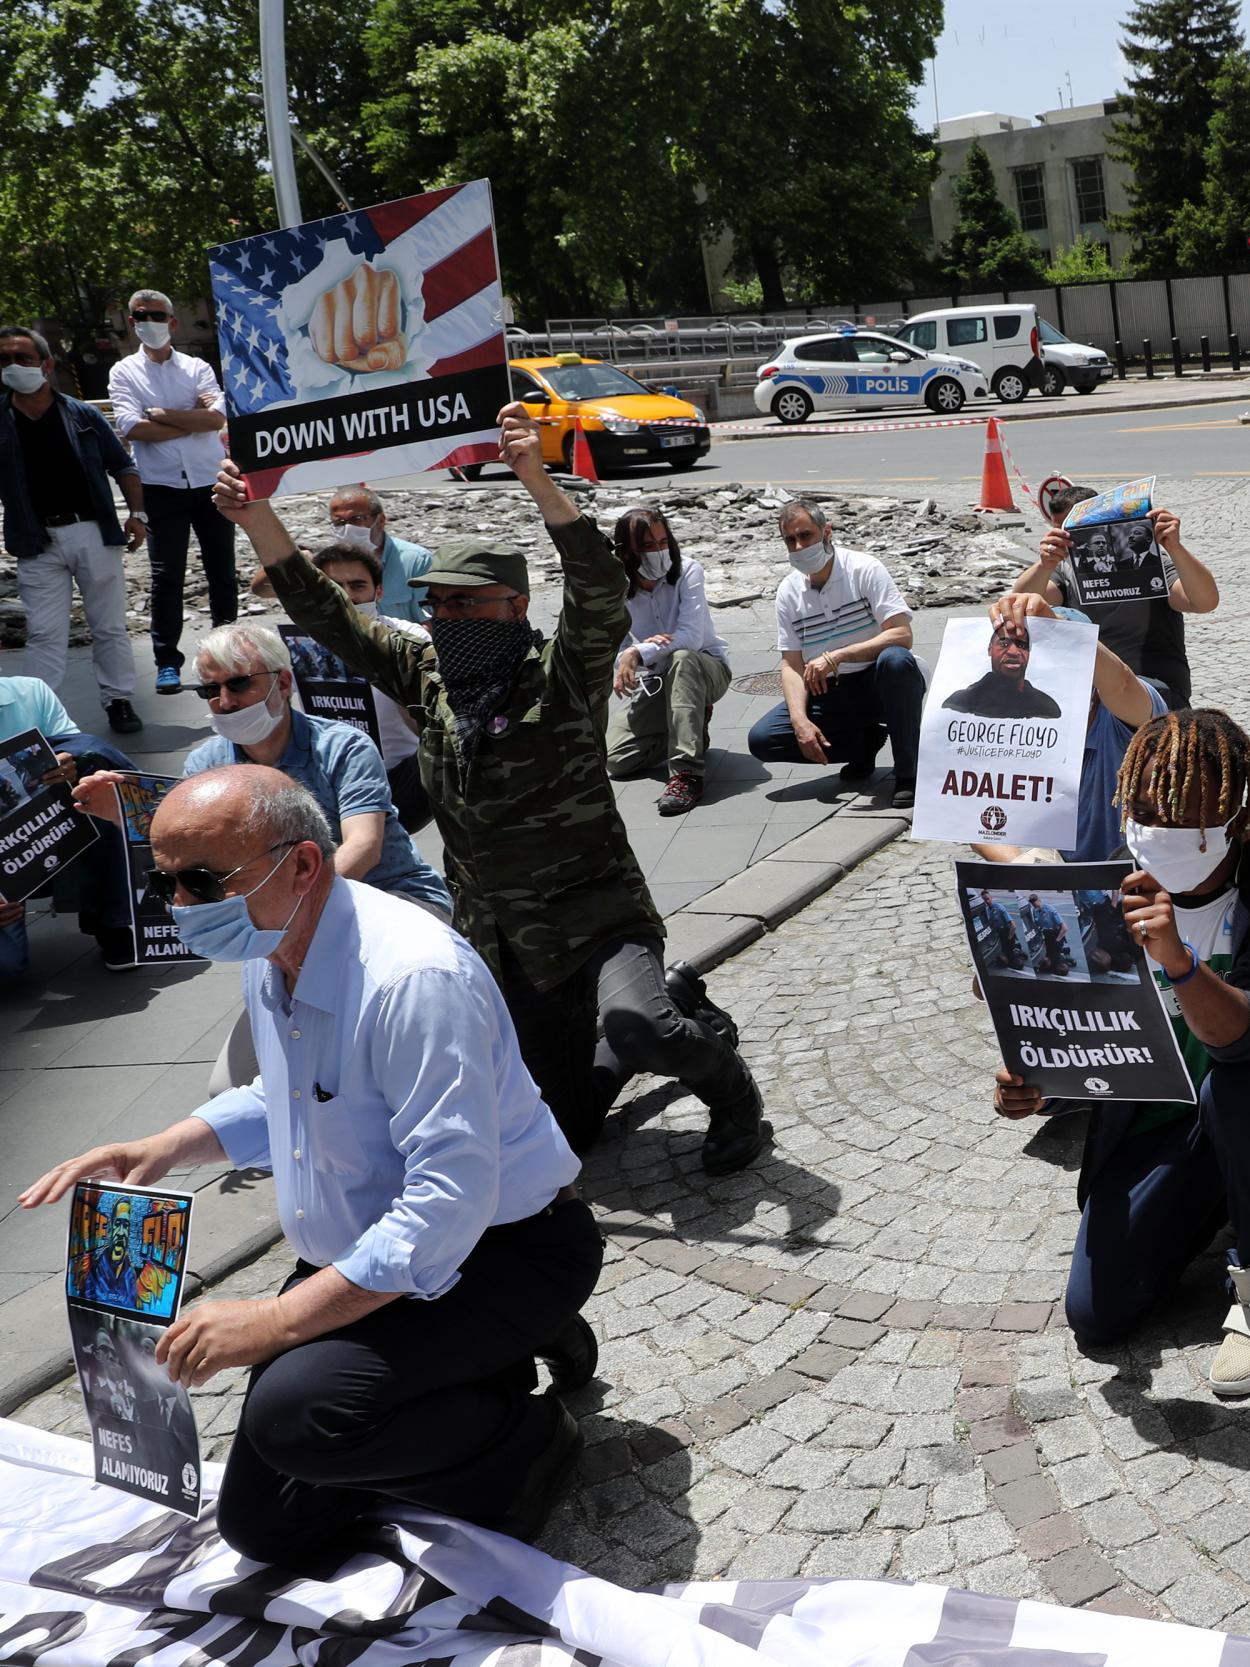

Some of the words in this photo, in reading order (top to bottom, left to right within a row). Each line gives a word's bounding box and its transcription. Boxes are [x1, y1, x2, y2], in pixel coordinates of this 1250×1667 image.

[866, 377, 909, 392] POLİS
[255, 417, 335, 458] DOWN
[341, 403, 410, 441] WITH
[417, 392, 471, 428] USA
[1082, 579, 1110, 589] NEFES
[1086, 587, 1142, 600] ALAMIYORUZ
[311, 696, 366, 712] IRKÇILILIK
[948, 720, 1006, 745] GEORGE
[1010, 723, 1058, 749] FLOYD
[941, 769, 1054, 803] ADALET!
[2, 818, 76, 875] ÖLDÜRÜR!
[144, 926, 180, 938] NEFE
[1010, 1004, 1141, 1036] IRKÇILILIK
[1020, 1040, 1154, 1068] ÖLDÜRÜR!
[98, 1428, 132, 1454] NEFES
[102, 1456, 168, 1495] ALAMIYORUZ
